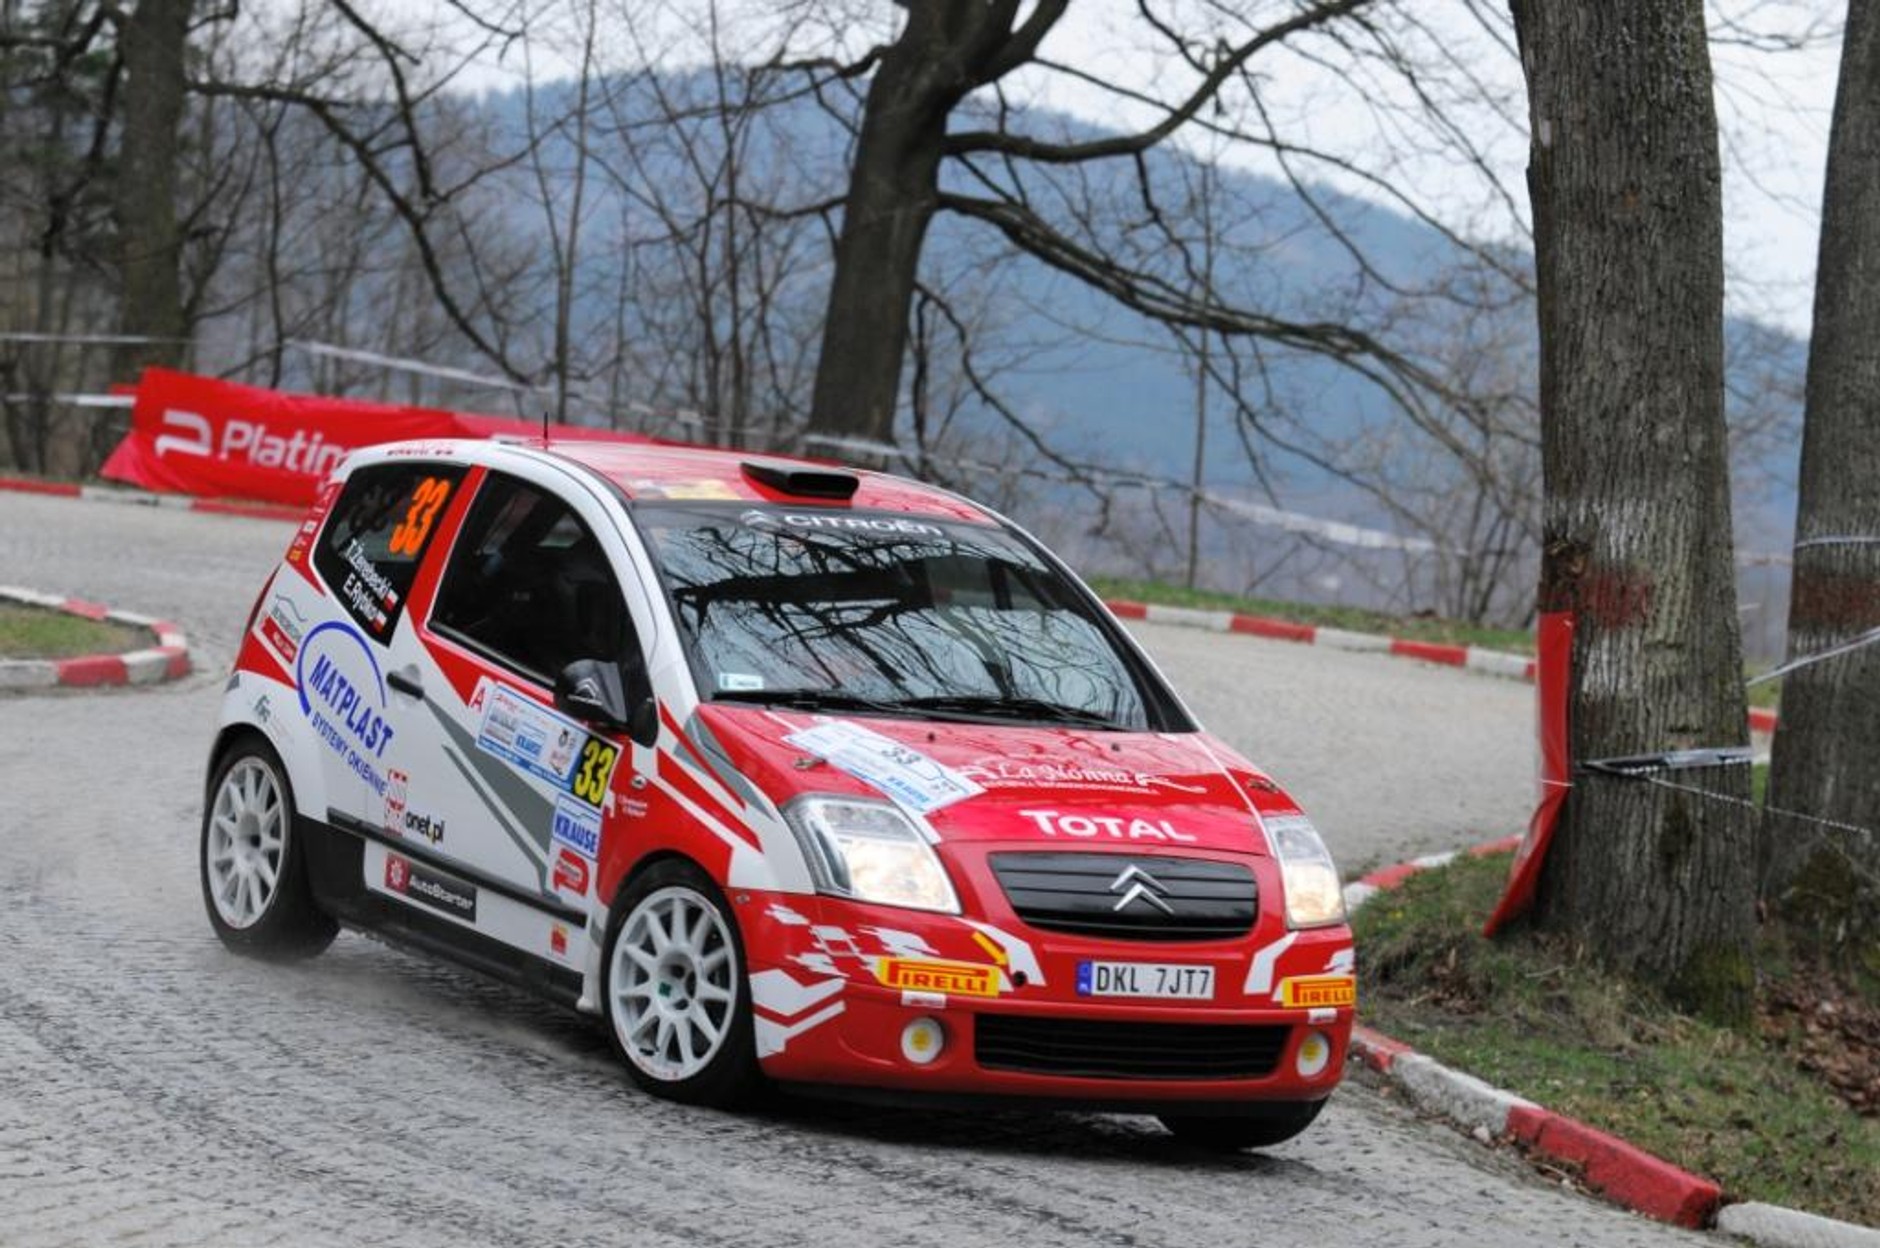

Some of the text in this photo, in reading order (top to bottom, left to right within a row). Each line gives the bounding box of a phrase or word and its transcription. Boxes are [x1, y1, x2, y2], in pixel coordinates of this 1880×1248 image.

[388, 477, 450, 556] 33
[308, 653, 394, 758] MATPLAST
[470, 687, 486, 713] A
[312, 711, 388, 797] SYSTEMY OKIENNE
[881, 746, 922, 765] 33
[573, 739, 615, 804] 33
[405, 811, 446, 845] onet.pl
[553, 813, 598, 854] KRAUSE
[1019, 809, 1198, 842] TOTAL
[888, 961, 989, 993] PIRELLI
[1096, 965, 1210, 995] DKL 7JT7
